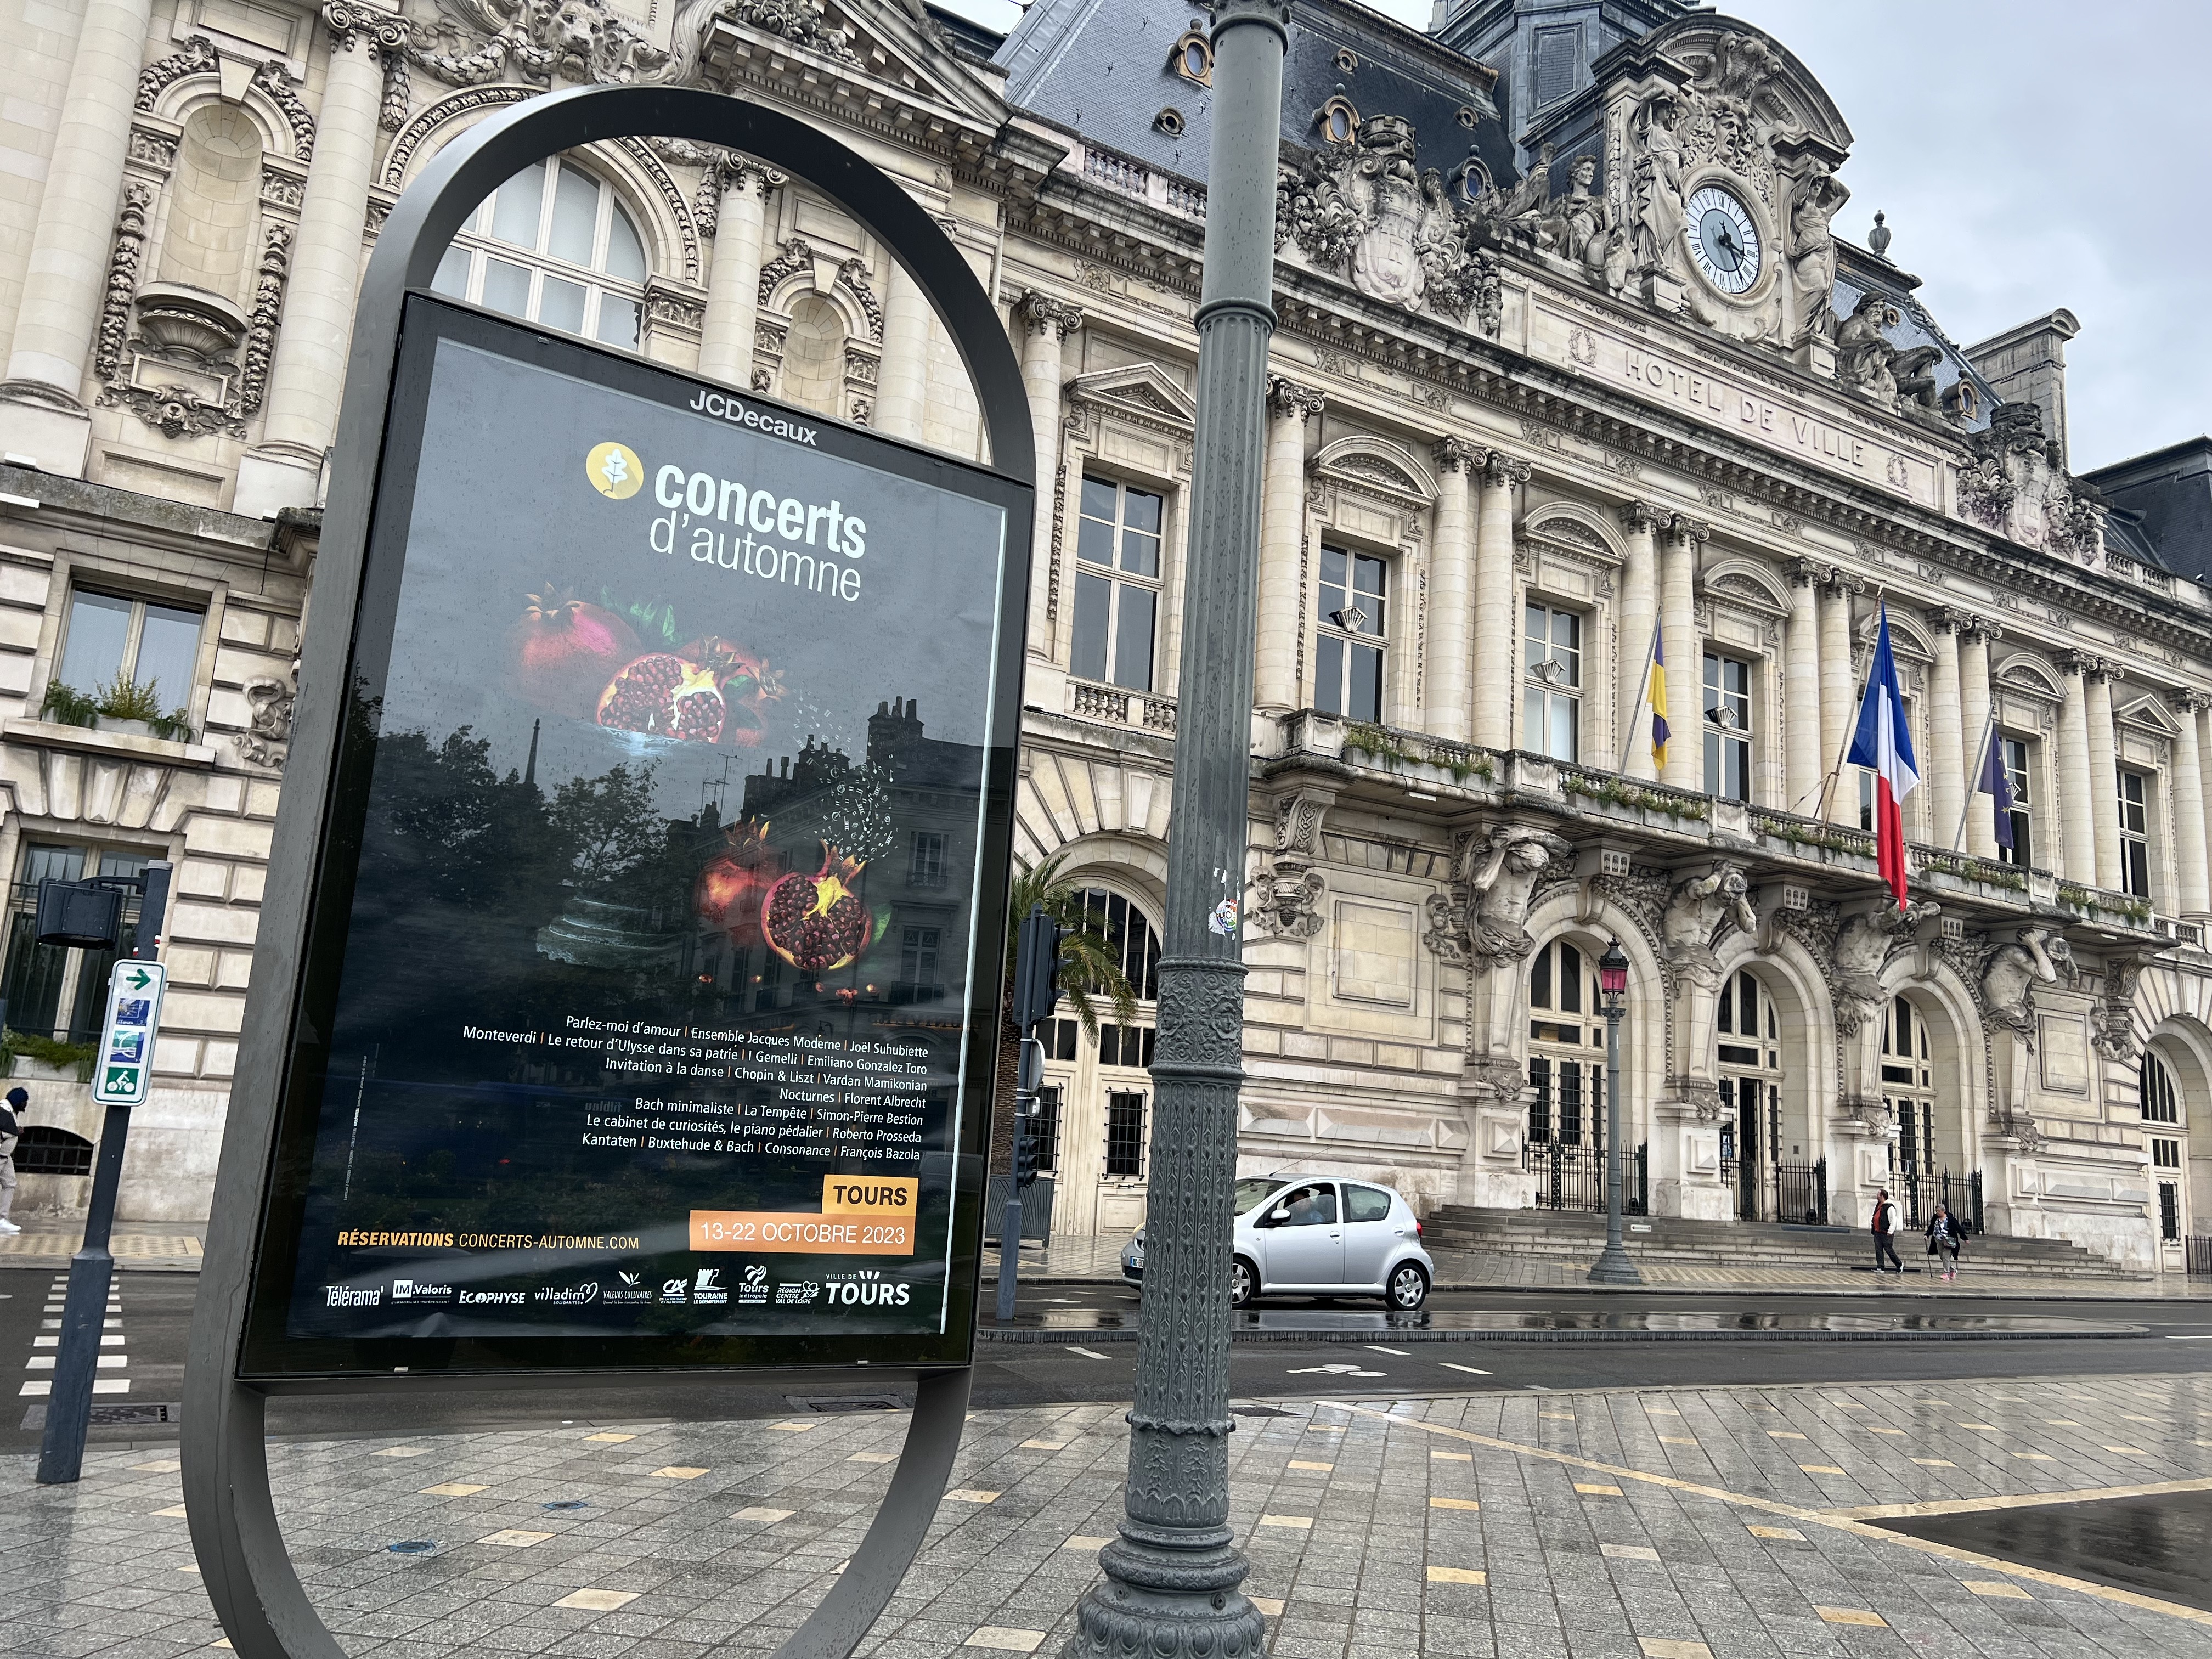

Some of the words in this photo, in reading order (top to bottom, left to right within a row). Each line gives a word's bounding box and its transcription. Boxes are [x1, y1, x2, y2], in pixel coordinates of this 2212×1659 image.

[689, 390, 817, 447] JCDecaux
[1626, 350, 1722, 412] HOTEL
[1740, 396, 1773, 432] DE
[1792, 416, 1864, 467] VILLE
[654, 464, 866, 558] concerts
[650, 511, 861, 602] d'automne
[463, 1025, 537, 1043] Monteverdi
[548, 1033, 562, 1046] Le
[566, 1036, 603, 1049] retour
[606, 1037, 655, 1055] d'Ulysse
[658, 1042, 686, 1056] dans
[689, 1048, 702, 1057] sa
[705, 1048, 738, 1061] patrie
[748, 1050, 752, 1062] I
[755, 1051, 797, 1065] Gemelli
[808, 1054, 853, 1069] Emiliano
[856, 1059, 903, 1073] Gonzalez
[905, 1062, 927, 1075] Toro
[566, 1015, 629, 1032] Parlez-moi
[632, 1021, 681, 1037] d'amour
[691, 1027, 744, 1042] Ensemble
[747, 1032, 789, 1048] Jacques
[793, 1036, 841, 1051] Moderne
[850, 1041, 871, 1053] Joël
[873, 1043, 928, 1058] Suhubiette
[605, 1057, 662, 1073] Invitation
[665, 1062, 673, 1074] à
[676, 1062, 687, 1075] la
[690, 1063, 724, 1077] danse
[735, 1066, 774, 1083] Chopin
[777, 1070, 786, 1082] &
[789, 1071, 814, 1084] Liszt
[823, 1073, 861, 1087] Vardan
[864, 1076, 927, 1091] Mamikonian
[635, 1097, 663, 1111] Bach
[667, 1099, 734, 1115] minimaliste
[744, 1104, 757, 1116] La
[760, 1105, 807, 1121] Tempête
[816, 1108, 883, 1123] Simon-Pierre
[887, 1113, 923, 1125] Bestion
[780, 1088, 834, 1103] Nocturnes
[845, 1092, 882, 1105] Florent
[883, 1094, 927, 1108] Albrecht
[586, 1113, 600, 1126] Le
[604, 1114, 648, 1129] cabinet
[651, 1117, 665, 1130] de
[669, 1119, 726, 1135] curiosités,
[730, 1121, 741, 1134] le
[743, 1122, 775, 1137] piano
[778, 1125, 823, 1139] pédalier
[832, 1127, 873, 1141] Roberto
[876, 1130, 921, 1143] Prosseda
[582, 1133, 636, 1147] Kantaten
[648, 1136, 710, 1151] Buxtehude
[714, 1139, 723, 1152] &
[726, 1140, 754, 1153] Bach
[765, 1142, 831, 1156] Consonance
[840, 1146, 882, 1161] François
[885, 1148, 920, 1160] Bazola
[833, 1185, 907, 1206] TOURS
[337, 1228, 454, 1247] RÉSERVATIONS
[459, 1233, 639, 1249] CONCERTS-AUTOMNE.COM
[701, 1222, 755, 1241] 13-22
[762, 1222, 857, 1243] OCTOBRE
[862, 1226, 905, 1244] 2023
[603, 1290, 623, 1299] VALEURS
[624, 1290, 652, 1299] CULINAIRES
[738, 1283, 769, 1293] Tours
[825, 1282, 910, 1305] TOURS
